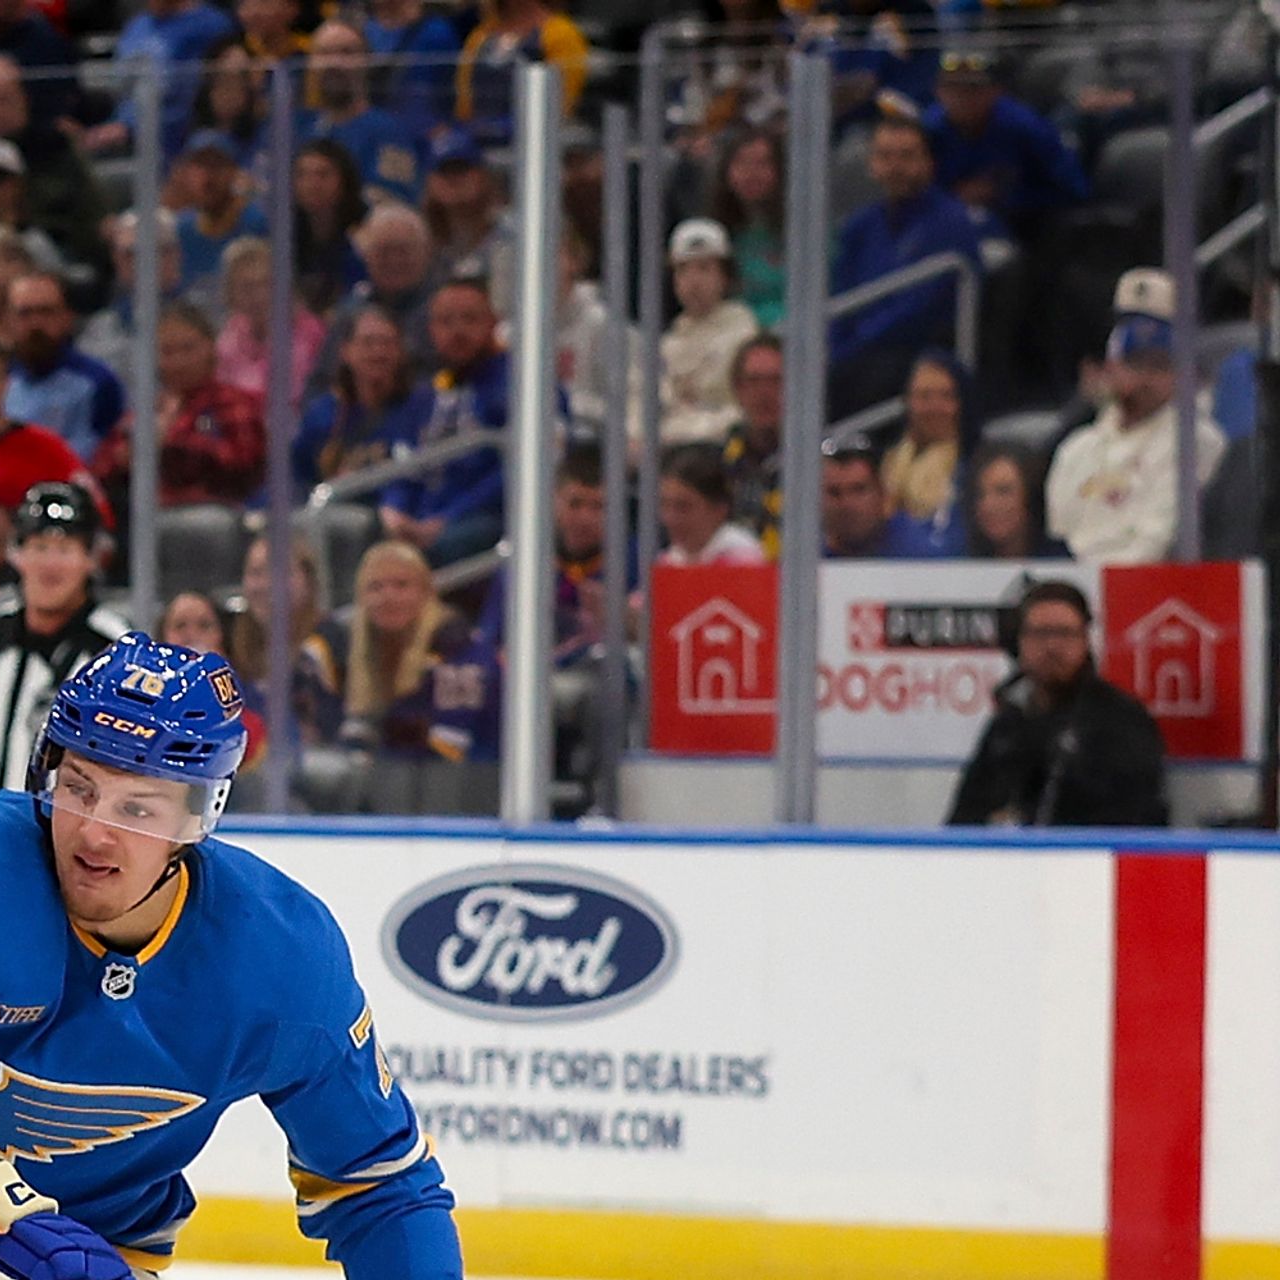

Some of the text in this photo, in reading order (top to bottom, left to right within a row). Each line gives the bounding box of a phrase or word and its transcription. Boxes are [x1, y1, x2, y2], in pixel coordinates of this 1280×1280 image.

[121, 663, 166, 697] 76
[817, 664, 997, 716] OGHO
[94, 711, 157, 739] CCM
[436, 885, 622, 997] Ford
[529, 1048, 616, 1091] FORD
